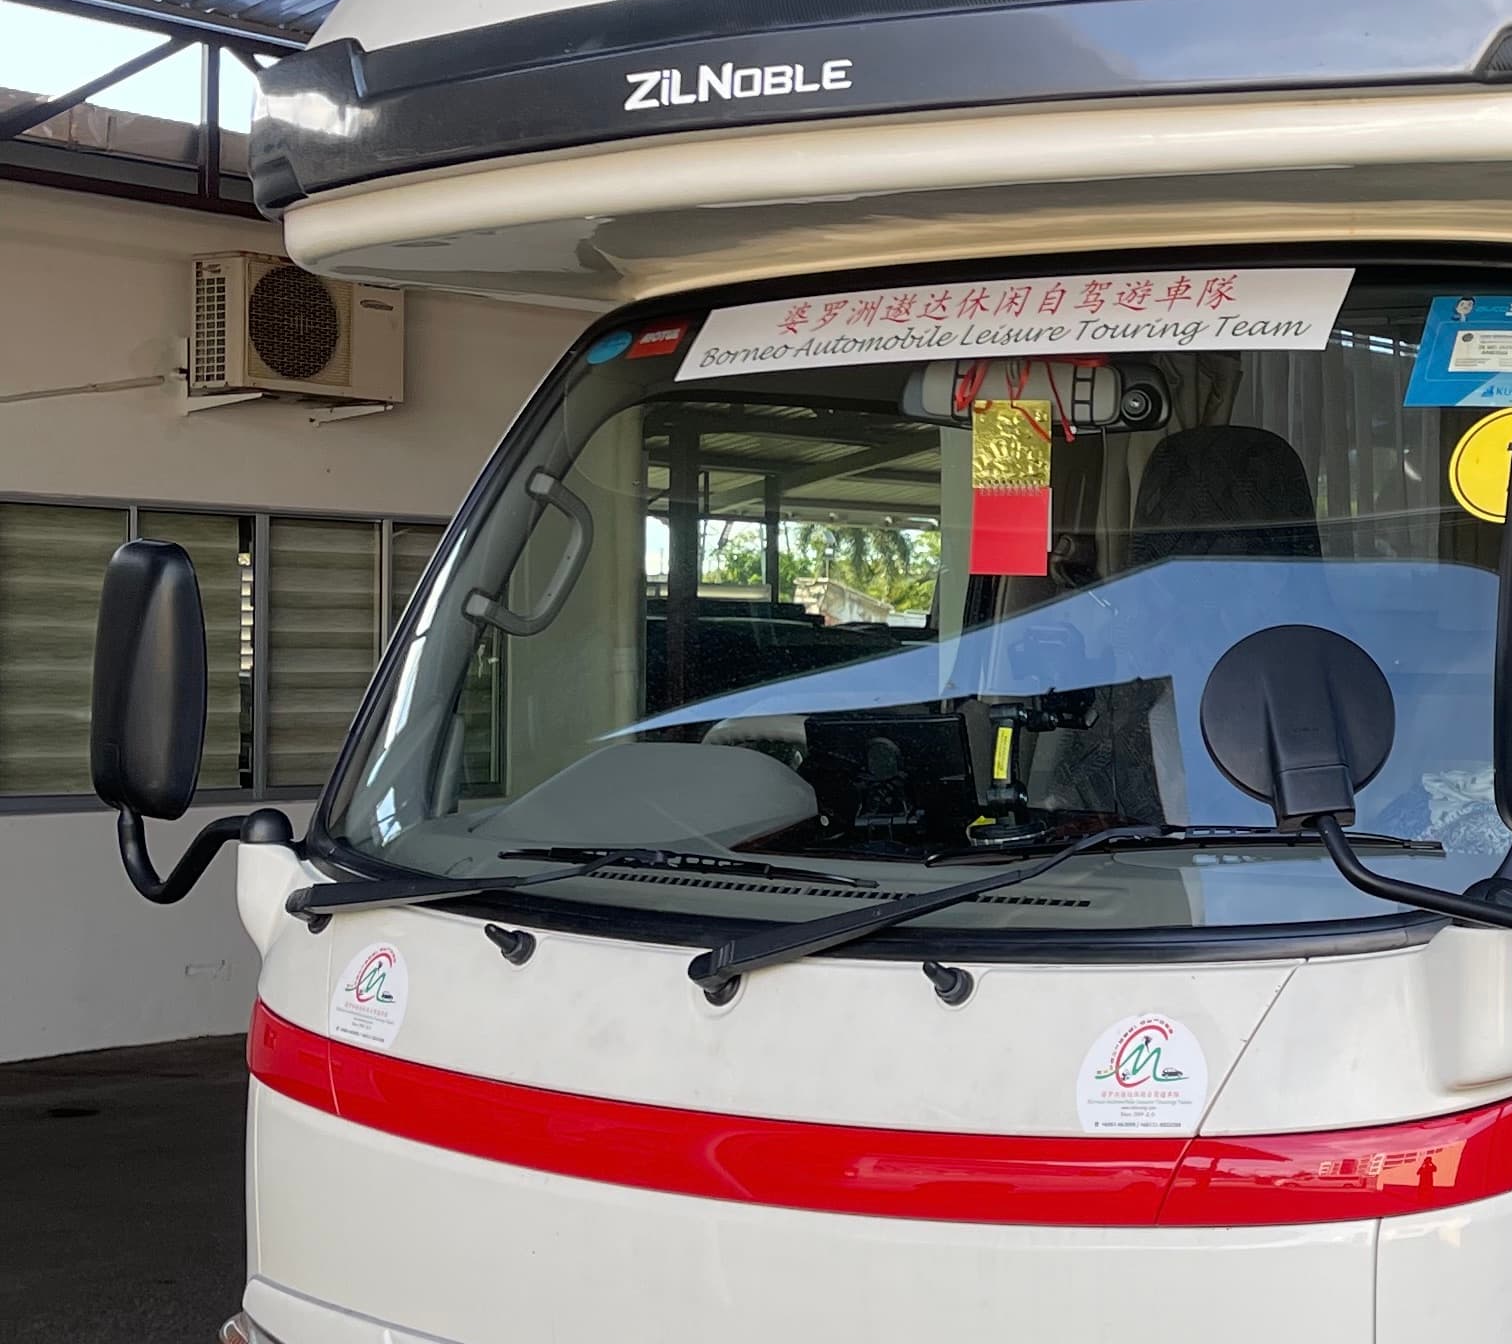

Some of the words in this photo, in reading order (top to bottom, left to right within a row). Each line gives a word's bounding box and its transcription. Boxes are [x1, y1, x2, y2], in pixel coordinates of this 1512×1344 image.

[700, 344, 797, 368] Borneo
[792, 324, 957, 358] Automobile
[959, 323, 1071, 346] Leisure
[1074, 316, 1210, 347] Touring
[1213, 314, 1313, 338] Team
